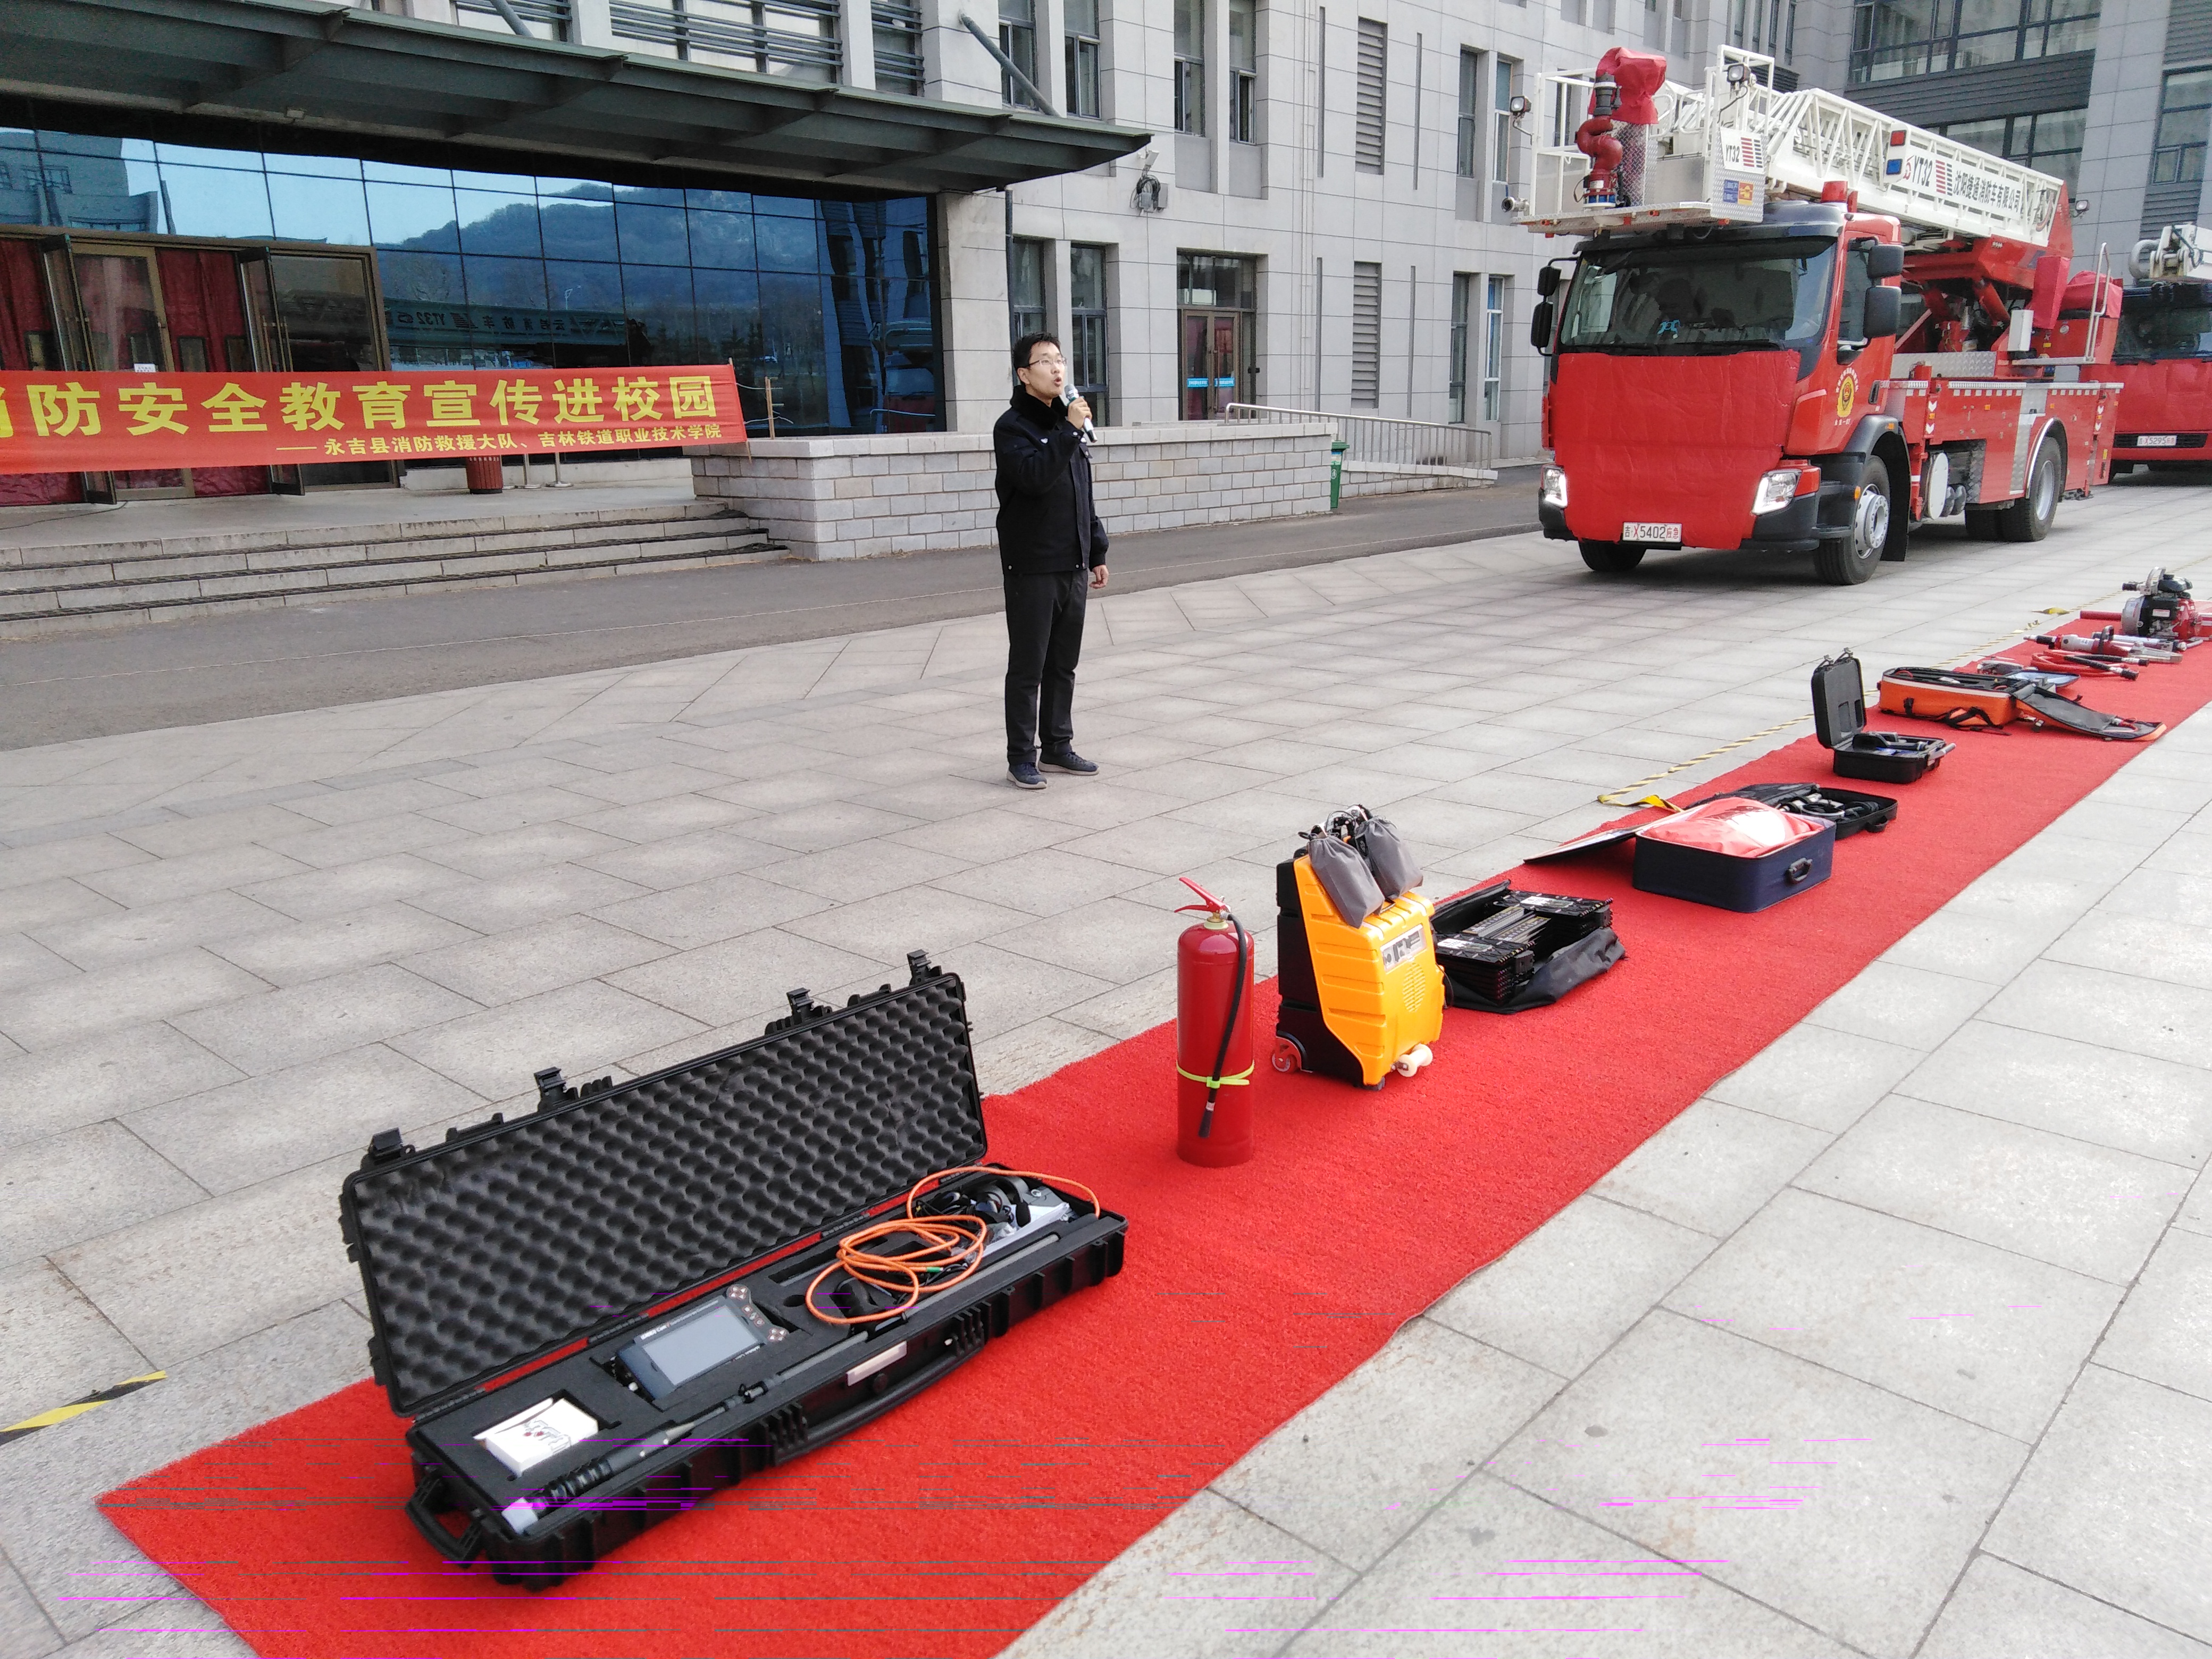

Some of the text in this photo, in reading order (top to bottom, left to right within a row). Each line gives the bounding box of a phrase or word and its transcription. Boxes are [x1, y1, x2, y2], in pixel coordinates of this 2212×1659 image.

[1725, 145, 1740, 163] YT32
[1912, 155, 2021, 213] YT32 沈阳捷通消防车有限公司
[0, 376, 716, 439] 防安全教育宣传进校园
